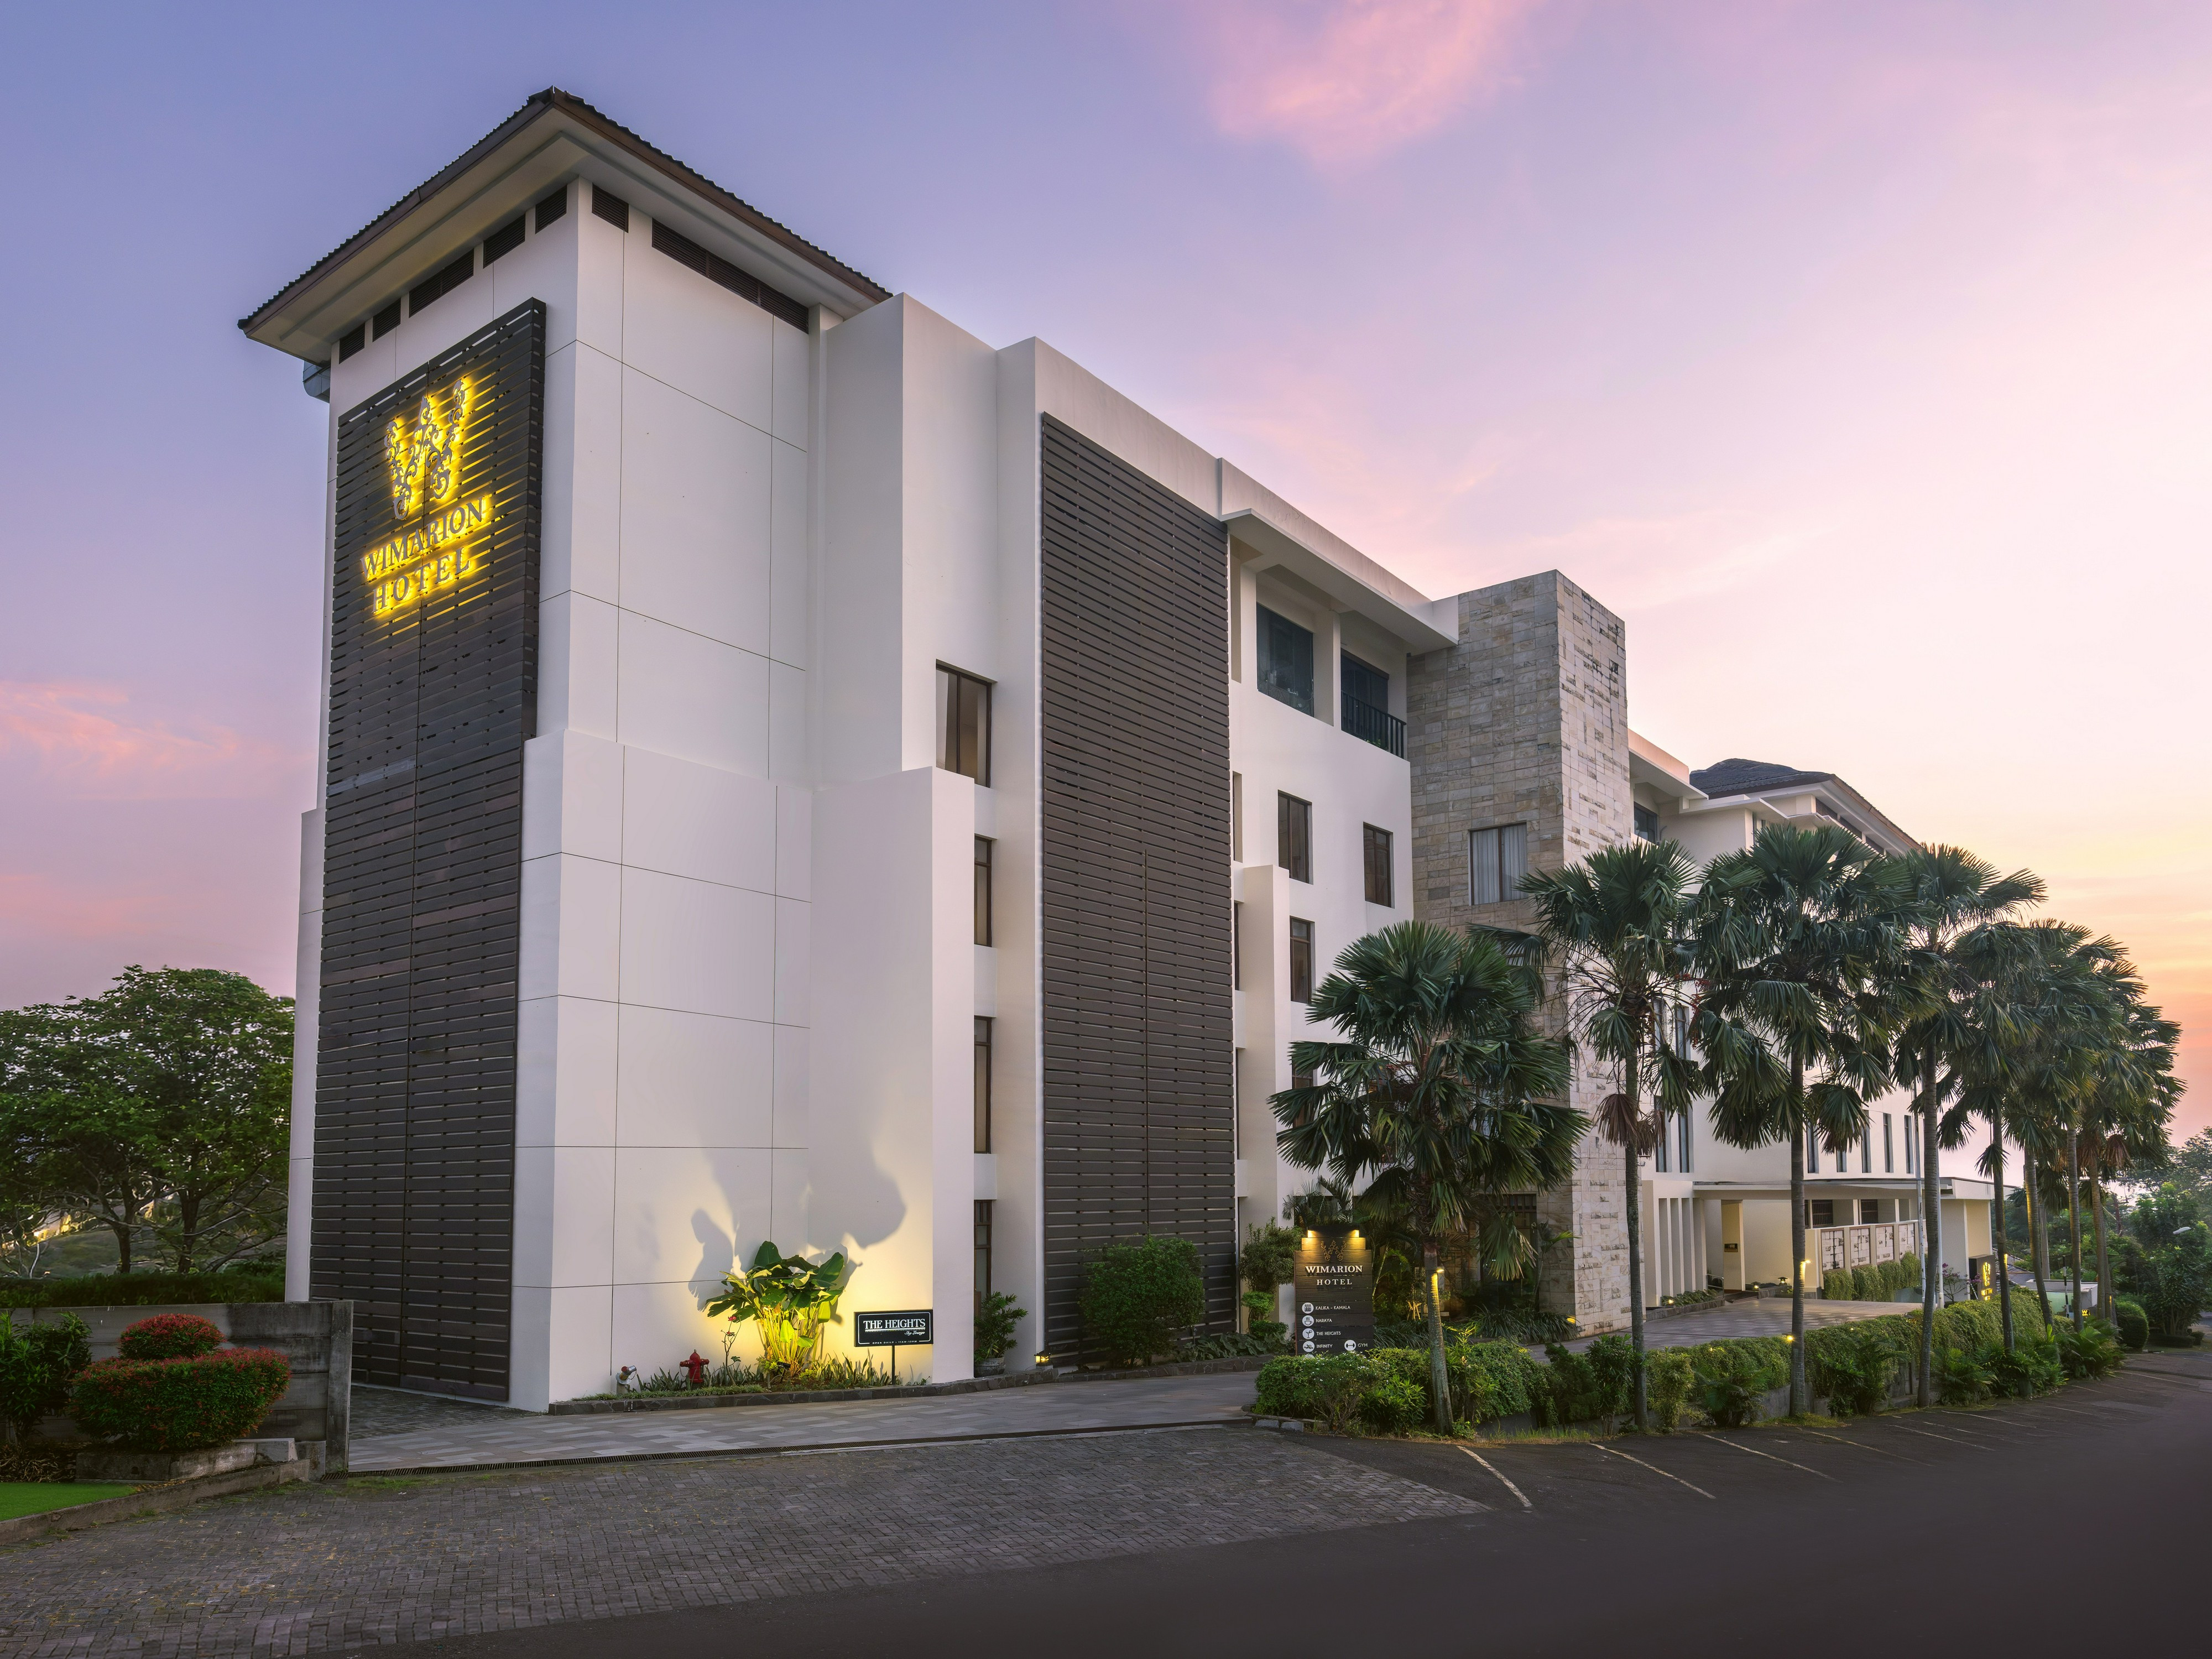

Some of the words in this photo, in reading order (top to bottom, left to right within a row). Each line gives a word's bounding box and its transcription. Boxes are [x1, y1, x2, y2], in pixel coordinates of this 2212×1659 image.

[360, 496, 484, 579] WIMARION
[372, 547, 469, 613] HOTEL
[863, 1320, 883, 1329] THE
[885, 1318, 926, 1328] HEIGHTS
